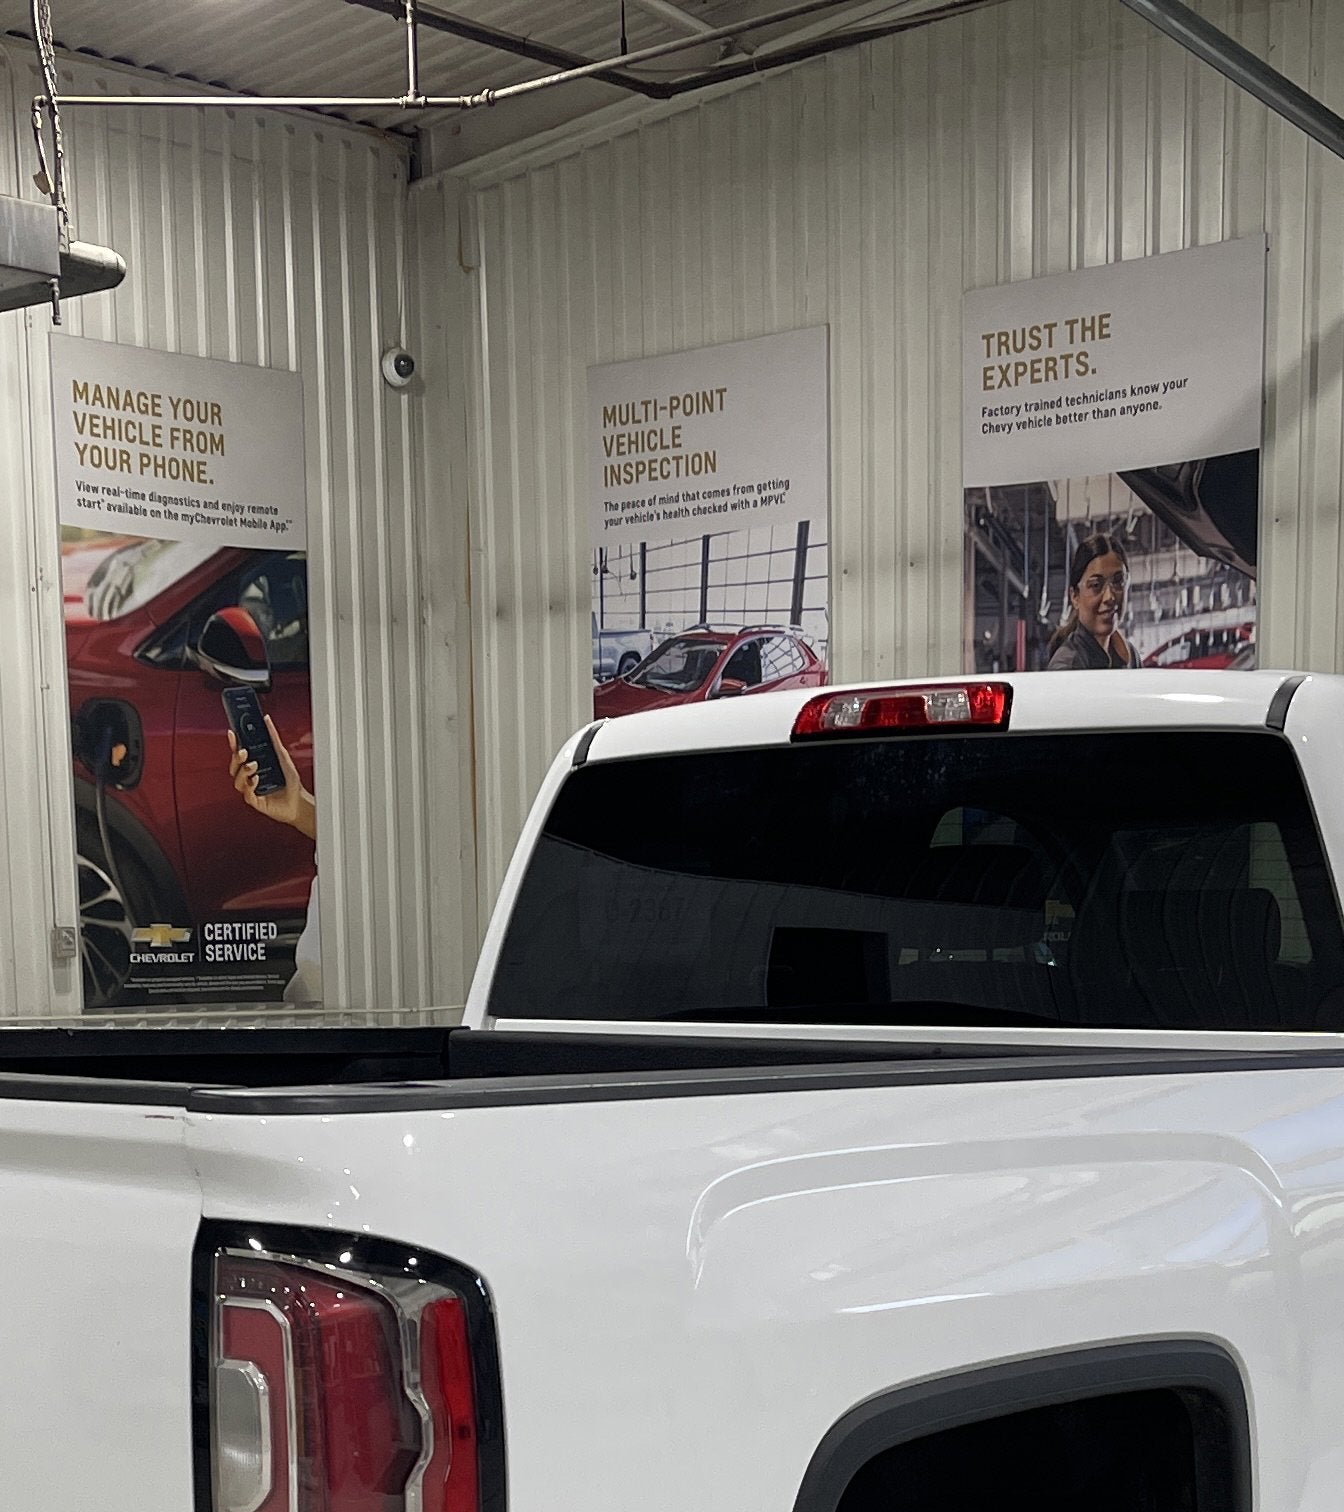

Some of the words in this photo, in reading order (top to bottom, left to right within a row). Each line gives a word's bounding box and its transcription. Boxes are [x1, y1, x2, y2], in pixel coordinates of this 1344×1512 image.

[981, 321, 1058, 358] TRUST
[1064, 313, 1111, 345] THE
[982, 351, 1097, 391] EXPERTS.
[72, 380, 162, 417] MANAGE
[168, 396, 222, 426] YOUR
[603, 387, 727, 429] MULTI-POINT
[982, 403, 1021, 418] Factory
[1024, 396, 1062, 413] trained
[1065, 387, 1127, 408] technicians
[1130, 382, 1159, 398] know
[1162, 377, 1189, 394] your
[73, 411, 163, 448] VEHICLE
[169, 428, 225, 456] FROM
[982, 419, 1013, 434] Chevy
[1016, 415, 1053, 430] vehicle
[1055, 410, 1089, 425] better
[1092, 405, 1117, 419] than
[1119, 400, 1163, 417] anyone.
[602, 425, 683, 458] VEHICLE
[74, 442, 132, 474] YOUR
[139, 452, 214, 484] PHONE.
[604, 450, 717, 488] INSPECTION
[75, 480, 98, 494] View
[101, 484, 145, 501] real-time
[148, 491, 200, 508] diagnostics
[203, 499, 219, 510] and
[221, 502, 244, 515] enjoy
[247, 504, 278, 516] remote
[604, 501, 619, 512] The
[621, 499, 645, 513] peace
[648, 495, 657, 507] of
[659, 493, 680, 506] mind
[682, 490, 700, 502] that
[702, 489, 730, 500] comes
[732, 484, 754, 496] from
[757, 479, 790, 496] getting
[604, 516, 622, 530] your
[625, 511, 661, 525] vehicle's
[662, 506, 690, 520] health
[692, 502, 728, 516] checked
[730, 498, 750, 511] with
[106, 501, 147, 517] available
[150, 508, 161, 518] on
[164, 508, 179, 520] the
[181, 511, 238, 527] myChevrolet
[240, 517, 267, 529] Mobile
[204, 922, 278, 941] CERTIFIED
[129, 953, 195, 963] CHEVROLET
[205, 943, 267, 962] SERVICE
